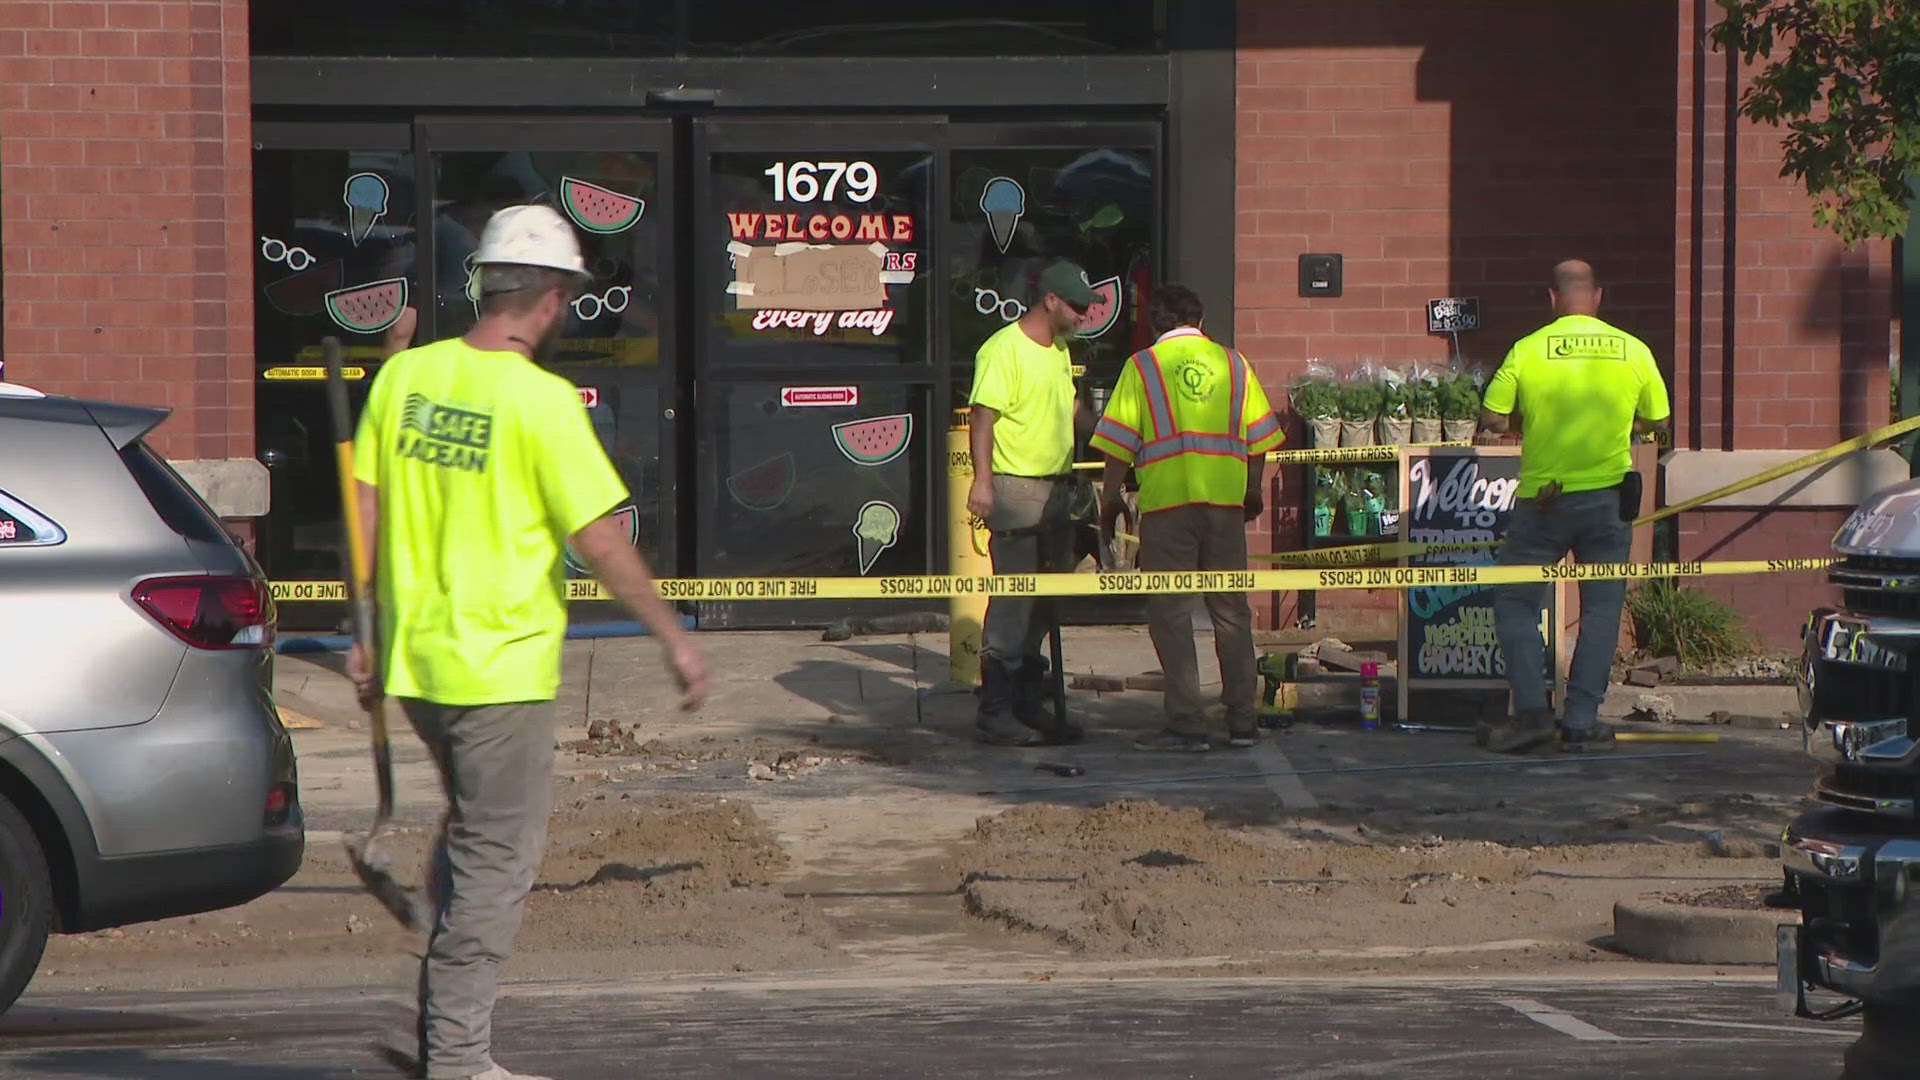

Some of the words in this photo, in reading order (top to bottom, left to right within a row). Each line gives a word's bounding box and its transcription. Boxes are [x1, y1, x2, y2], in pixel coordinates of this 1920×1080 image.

[764, 161, 878, 203] 1679
[727, 212, 914, 242] WELCOME
[1433, 305, 1462, 320] Basil
[752, 310, 835, 336] Every
[431, 409, 490, 444] SAFE
[1276, 452, 1296, 463] FIRE
[1300, 451, 1320, 462] LINE
[1323, 450, 1338, 461] DO
[1340, 449, 1359, 460] NOT
[1361, 447, 1394, 460] CROSS
[1410, 458, 1520, 522] Welco
[1454, 511, 1496, 528] TO
[1343, 550, 1361, 562] LINE
[1363, 547, 1380, 561] FIRE
[1395, 569, 1413, 584] DO
[1418, 568, 1445, 583] LINE
[1450, 568, 1478, 583] FIRE
[1542, 564, 1586, 579] CROSS
[1590, 563, 1615, 578] NOT
[1619, 562, 1637, 577] DO
[978, 577, 1004, 592] LINE
[1009, 576, 1036, 592] FIRE
[1099, 575, 1142, 590] CROSS
[1146, 574, 1169, 590] NOT
[1174, 574, 1192, 589] DO
[1196, 573, 1223, 589] LINE
[1228, 573, 1255, 588] FIRE
[1319, 571, 1363, 586] CROSS
[1367, 570, 1391, 585] NOT
[271, 585, 291, 598] NO
[295, 585, 312, 598] DO
[317, 584, 345, 598] LINE
[571, 584, 598, 596] FIRE
[661, 581, 704, 597] CROSS
[707, 580, 731, 596] NOT
[736, 580, 754, 596] DO
[758, 580, 785, 596] LINE
[790, 580, 817, 596] FIRE
[880, 579, 923, 594] CROSS
[928, 578, 950, 593] NOT
[955, 578, 973, 593] DO
[1458, 605, 1496, 628] you
[1418, 642, 1496, 675] GROCERY
